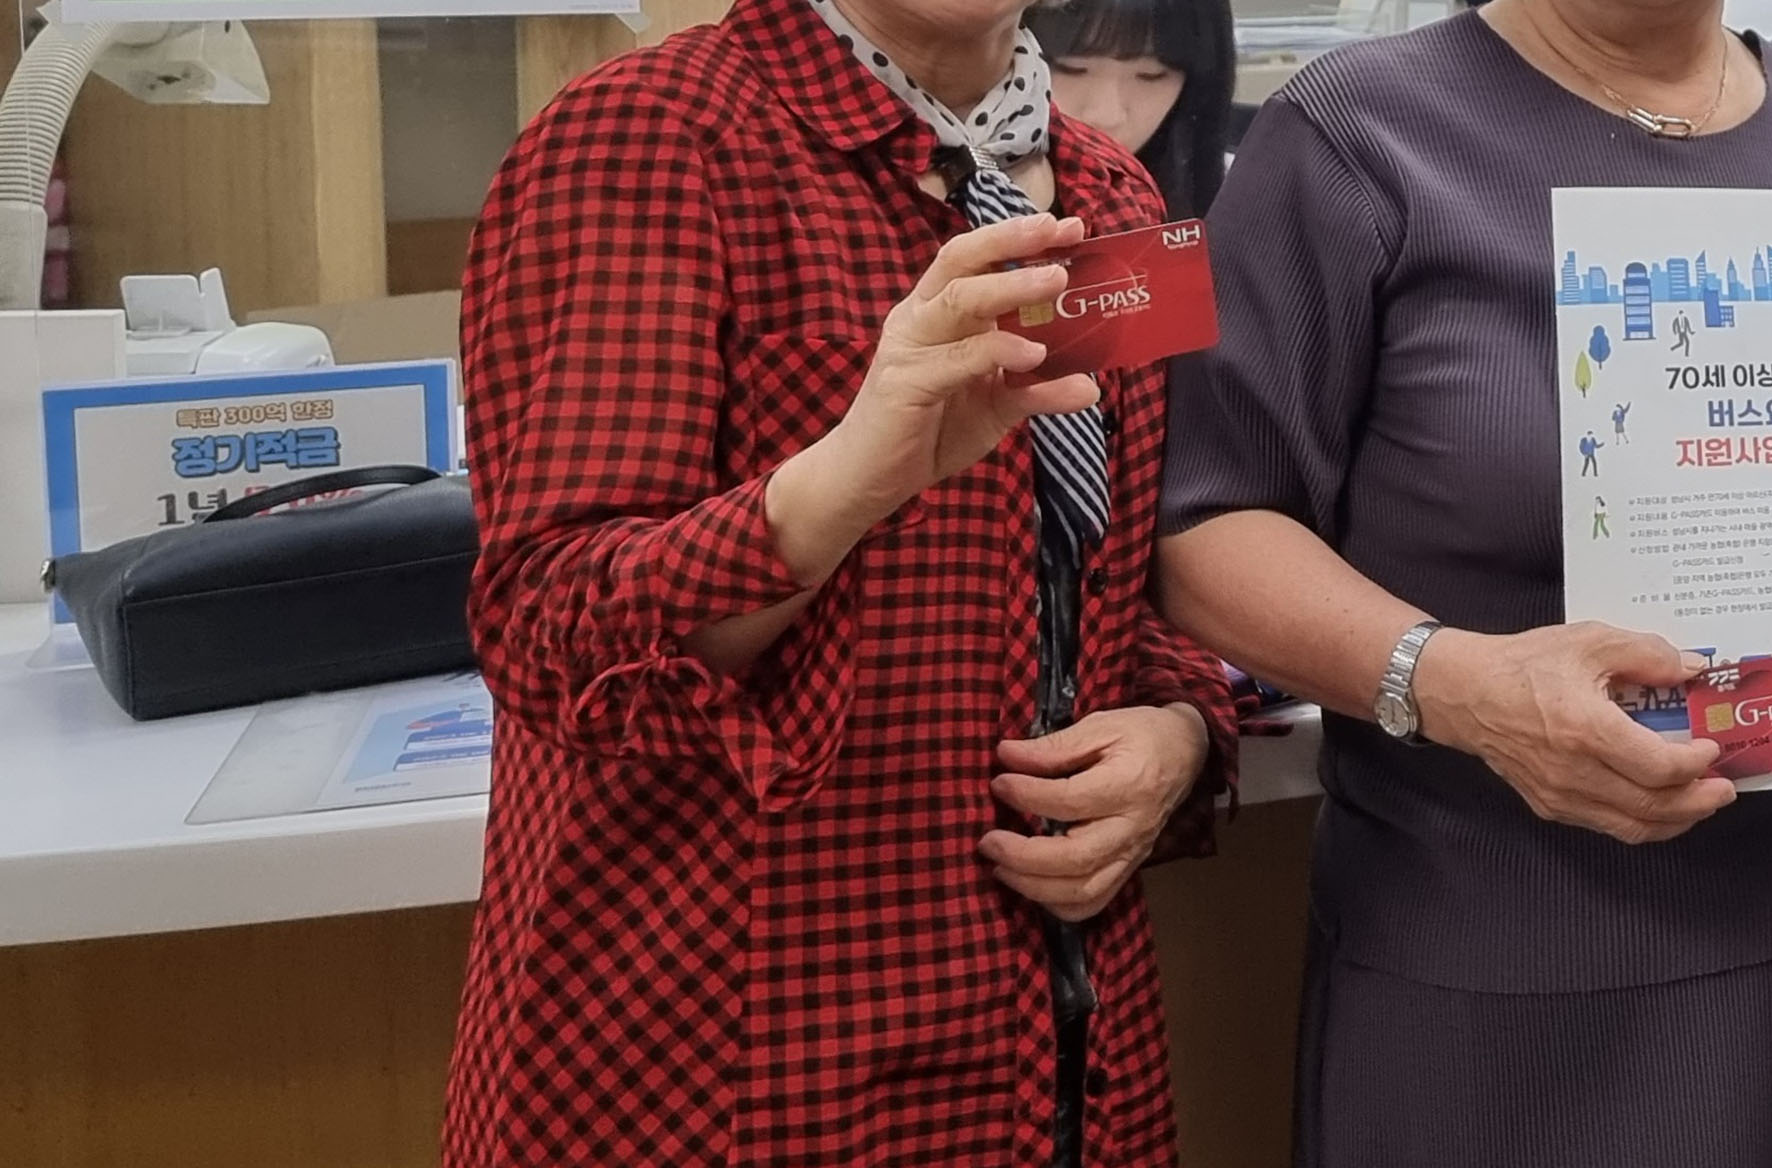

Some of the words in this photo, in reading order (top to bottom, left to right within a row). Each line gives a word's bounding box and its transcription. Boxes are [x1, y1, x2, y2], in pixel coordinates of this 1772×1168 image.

[1162, 224, 1200, 247] NH
[1056, 278, 1151, 319] G-PASS
[1665, 364, 1727, 391] 70세
[176, 407, 220, 430] 특판
[223, 402, 288, 425] 300억
[290, 399, 334, 421] 한정
[171, 426, 341, 479] 정기적금
